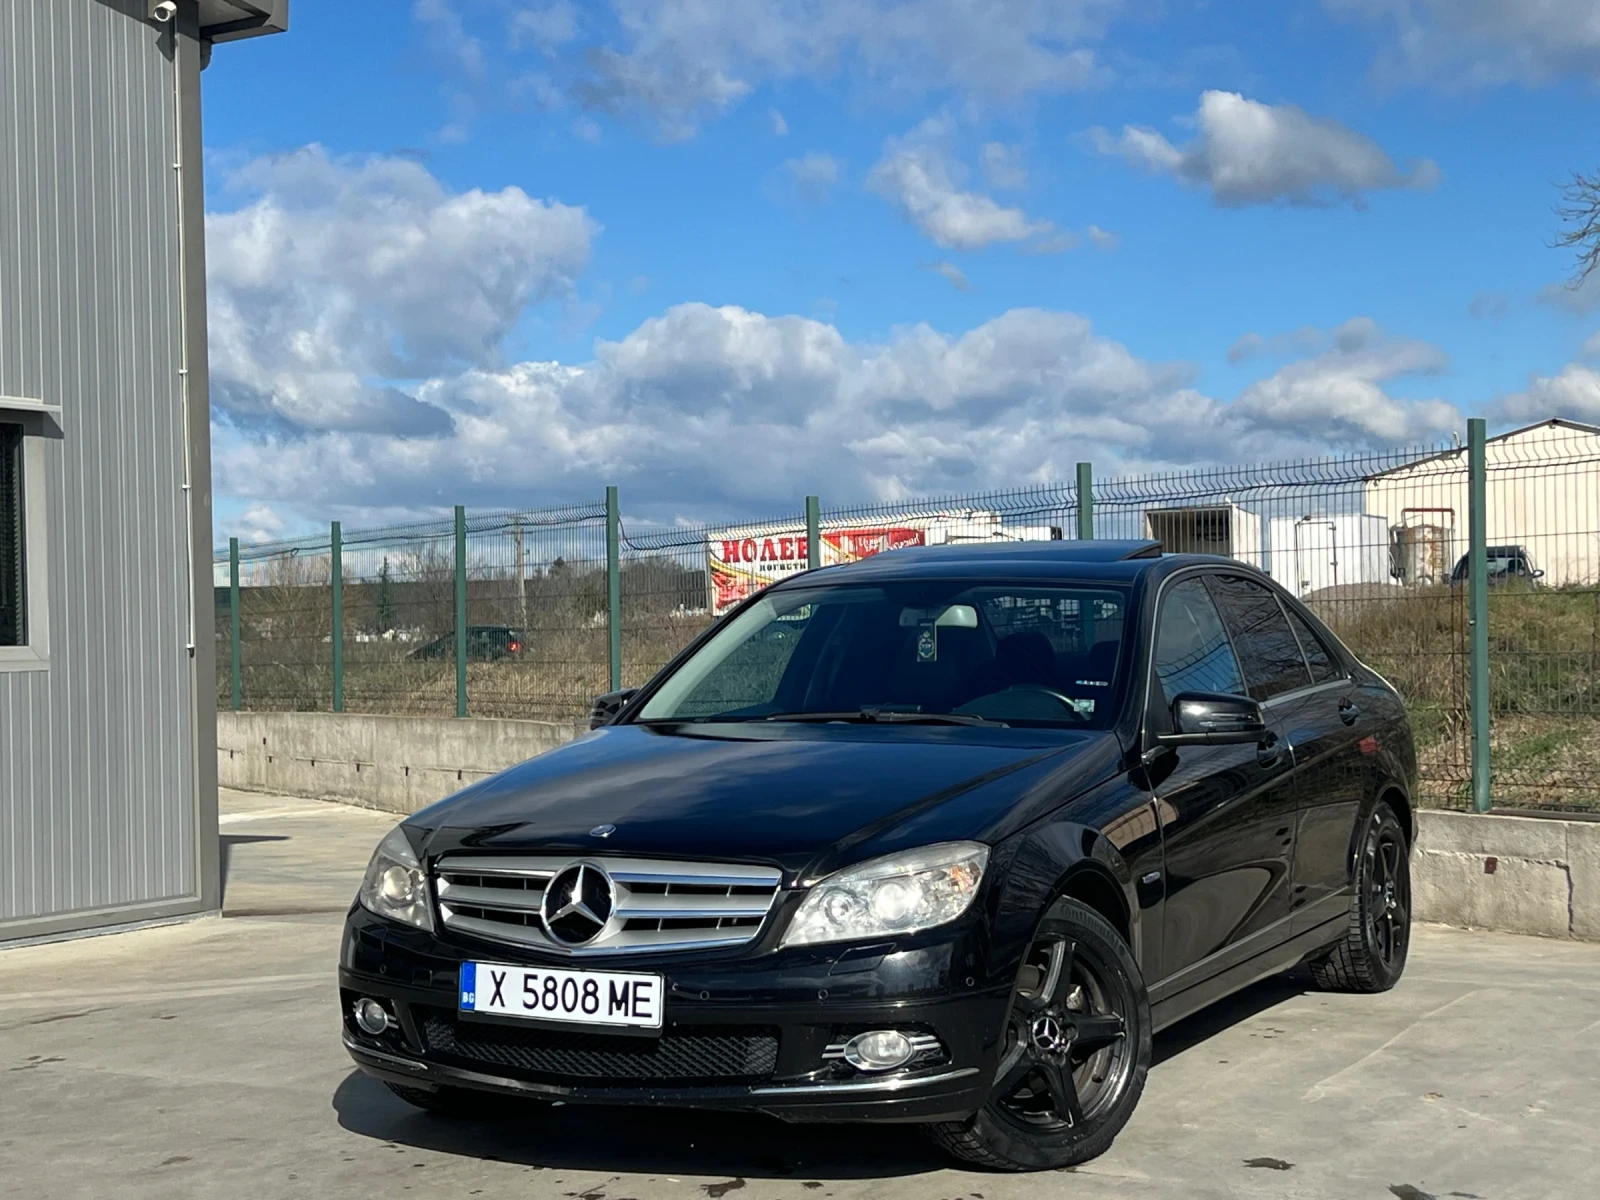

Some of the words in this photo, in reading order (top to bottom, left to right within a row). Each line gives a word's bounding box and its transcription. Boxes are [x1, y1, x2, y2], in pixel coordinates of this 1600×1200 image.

[462, 992, 475, 1004] BG
[489, 970, 507, 1008] X
[522, 973, 600, 1015] 5808
[608, 979, 653, 1019] ME
